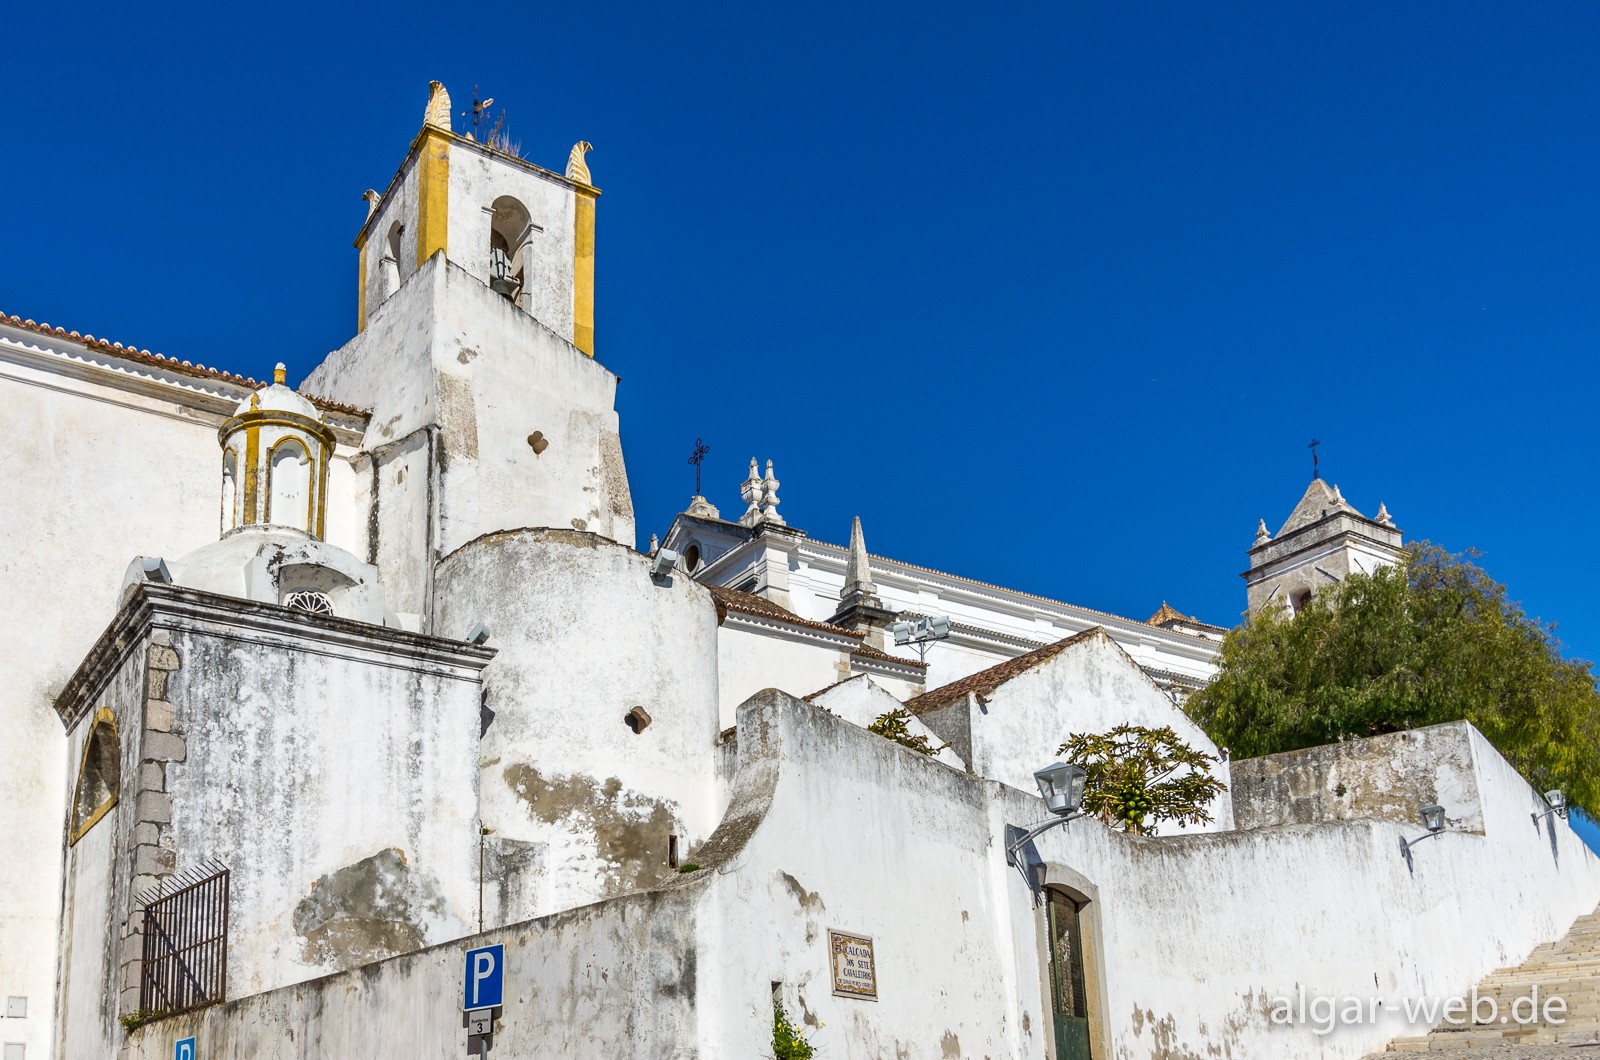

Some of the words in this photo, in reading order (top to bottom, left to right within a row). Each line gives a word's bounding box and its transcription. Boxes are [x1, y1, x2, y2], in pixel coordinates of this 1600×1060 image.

[845, 945, 870, 958] CALÇADA
[846, 959, 855, 967] DOS
[858, 960, 869, 970] SETE
[473, 952, 495, 1004] P
[843, 968, 872, 980] CAVALEIROS
[477, 1023, 483, 1033] 3
